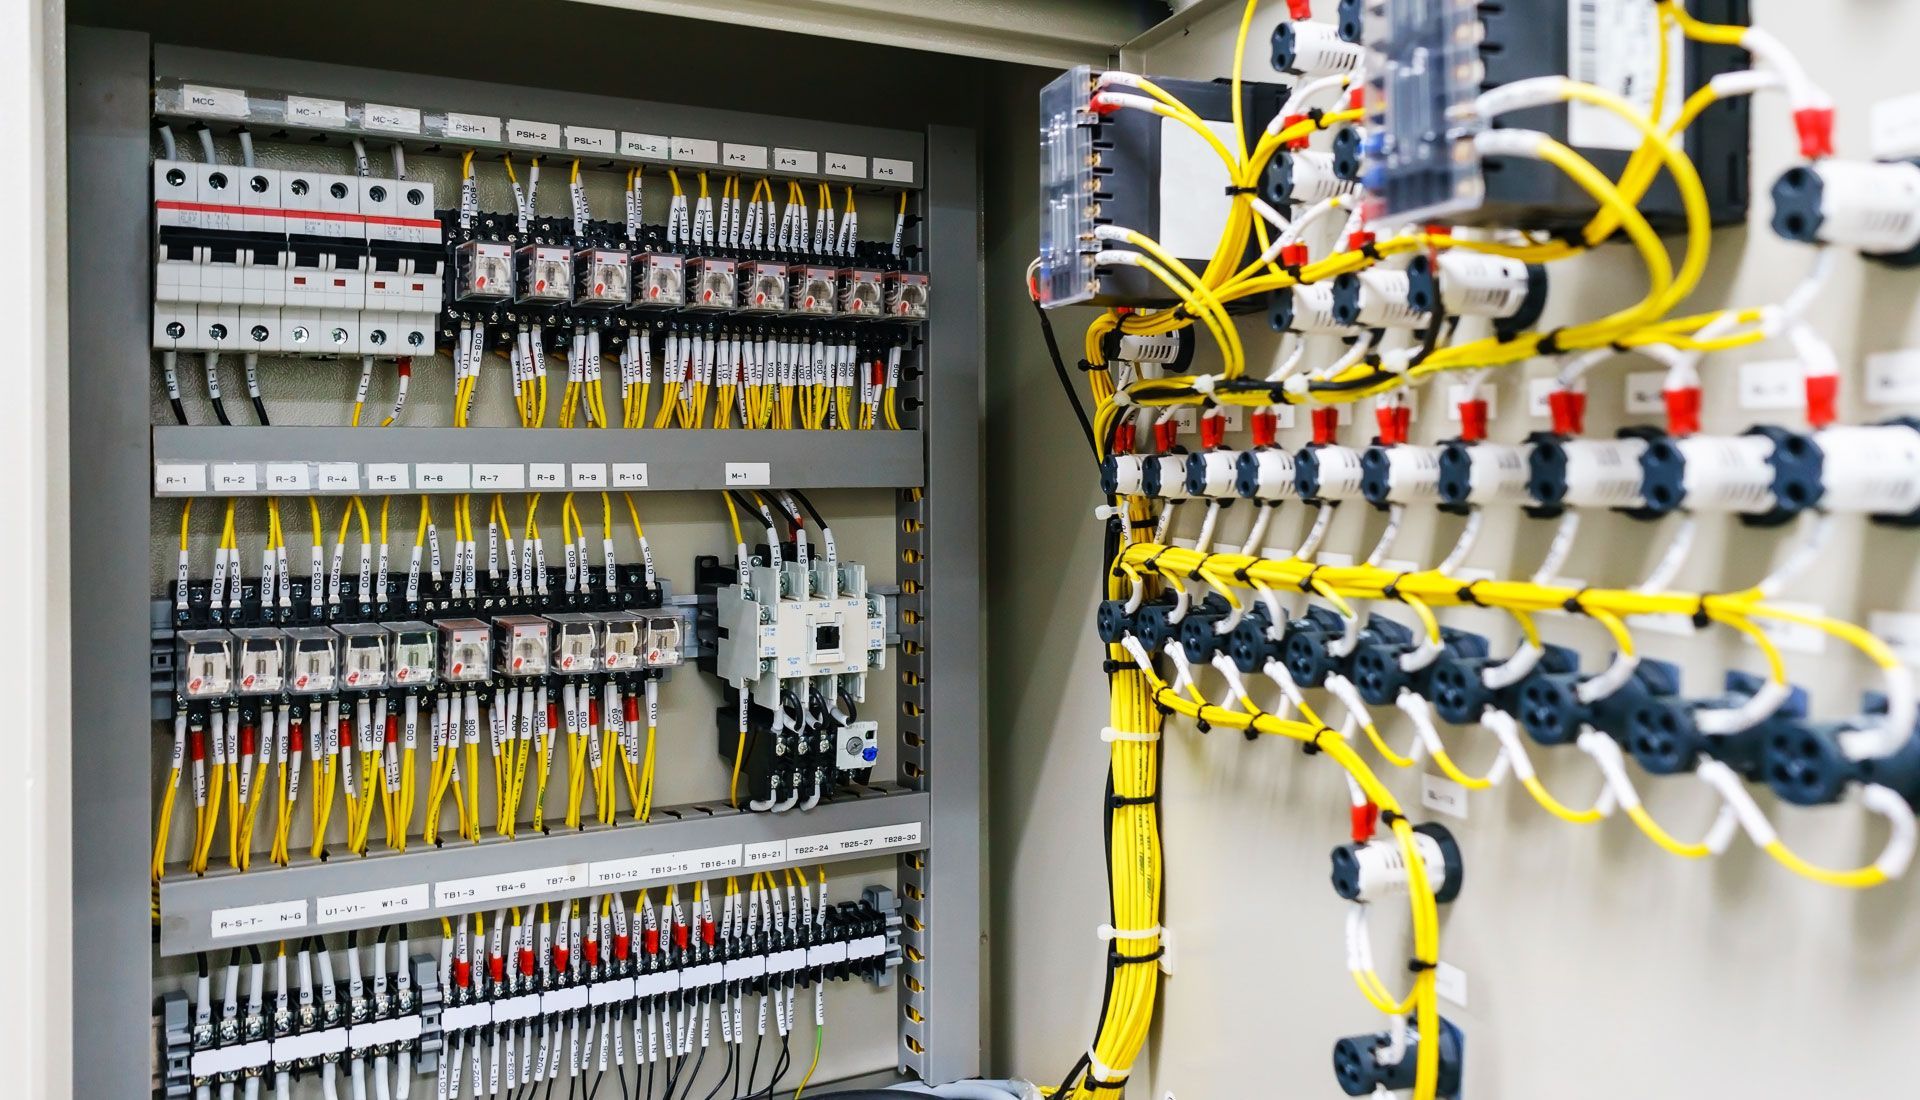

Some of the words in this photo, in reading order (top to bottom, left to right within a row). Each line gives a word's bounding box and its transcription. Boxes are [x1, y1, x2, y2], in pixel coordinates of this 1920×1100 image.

[192, 97, 215, 106] MCC
[296, 108, 323, 117] MC-1
[372, 116, 400, 125] MC-2
[455, 124, 486, 133] PSH-1
[516, 130, 547, 140] PSH-2
[574, 137, 602, 146] PSL-1
[628, 142, 656, 152] PSL-2
[729, 153, 746, 161] A-2
[462, 184, 470, 219] 011-13
[680, 206, 689, 234] 011-5
[695, 209, 705, 237] 011-3
[473, 333, 482, 362] 008-3
[166, 368, 177, 391] R1-1
[208, 367, 218, 391] S1-1
[248, 368, 257, 390] T1-1
[359, 373, 370, 396] L1-1
[395, 392, 405, 412] N1-1
[166, 476, 187, 484] R-1
[223, 476, 245, 484] R-2
[275, 475, 296, 483] R-3
[327, 475, 347, 483] R-4
[424, 474, 443, 482] R-6
[480, 474, 498, 482] R-7
[429, 530, 439, 566] 011-15
[828, 542, 836, 562] T1-1
[332, 555, 341, 587] 004-3
[379, 555, 387, 586] 005-3
[524, 547, 532, 581] 007-2+
[568, 550, 576, 579] 008-3
[643, 546, 654, 574] 010-5
[179, 564, 187, 596] 001-3
[213, 563, 224, 595] 001-2
[231, 561, 240, 593] 002-3
[263, 564, 272, 595] 002-2
[280, 558, 289, 590] 003-3
[410, 560, 420, 591] 005-2
[376, 724, 384, 742] 005
[406, 723, 415, 741] 005
[468, 719, 476, 736] 006
[521, 715, 529, 733] 007
[263, 736, 272, 755] 002
[329, 728, 337, 747] 004
[173, 741, 182, 759] 001
[240, 773, 248, 796] N1-1
[291, 770, 300, 792] N1-1
[794, 844, 828, 854] TB22-24
[840, 839, 873, 848] TB25-27
[884, 834, 916, 844] TB28-30
[748, 851, 781, 860] B19-21
[599, 870, 637, 881] TB10-12
[651, 864, 688, 874] TB13-15
[700, 859, 736, 869] TB16-18
[443, 889, 475, 899] TB1-3
[495, 882, 526, 892] TB4-6
[546, 876, 576, 885] TB7-9
[325, 905, 366, 916] U1-V1-
[382, 898, 408, 908] W1-G
[675, 904, 685, 924] N1-1
[750, 903, 758, 930] 011-3
[774, 900, 783, 927] 011-5
[220, 918, 263, 929] R-S-T-
[280, 912, 301, 921] N-G
[618, 911, 626, 937] N1-1
[647, 909, 656, 930] N1-1
[723, 909, 731, 936] 011-1
[475, 948, 483, 977] 002-2
[325, 985, 332, 995] U1
[352, 980, 361, 991] V1
[280, 993, 287, 1001] N
[721, 1009, 730, 1036] 011-1
[536, 1045, 546, 1073] 004-2
[552, 1049, 560, 1071] N1-1
[584, 1041, 592, 1062] N1-1
[439, 1063, 447, 1093] 001-2
[452, 1068, 460, 1091] N1-1
